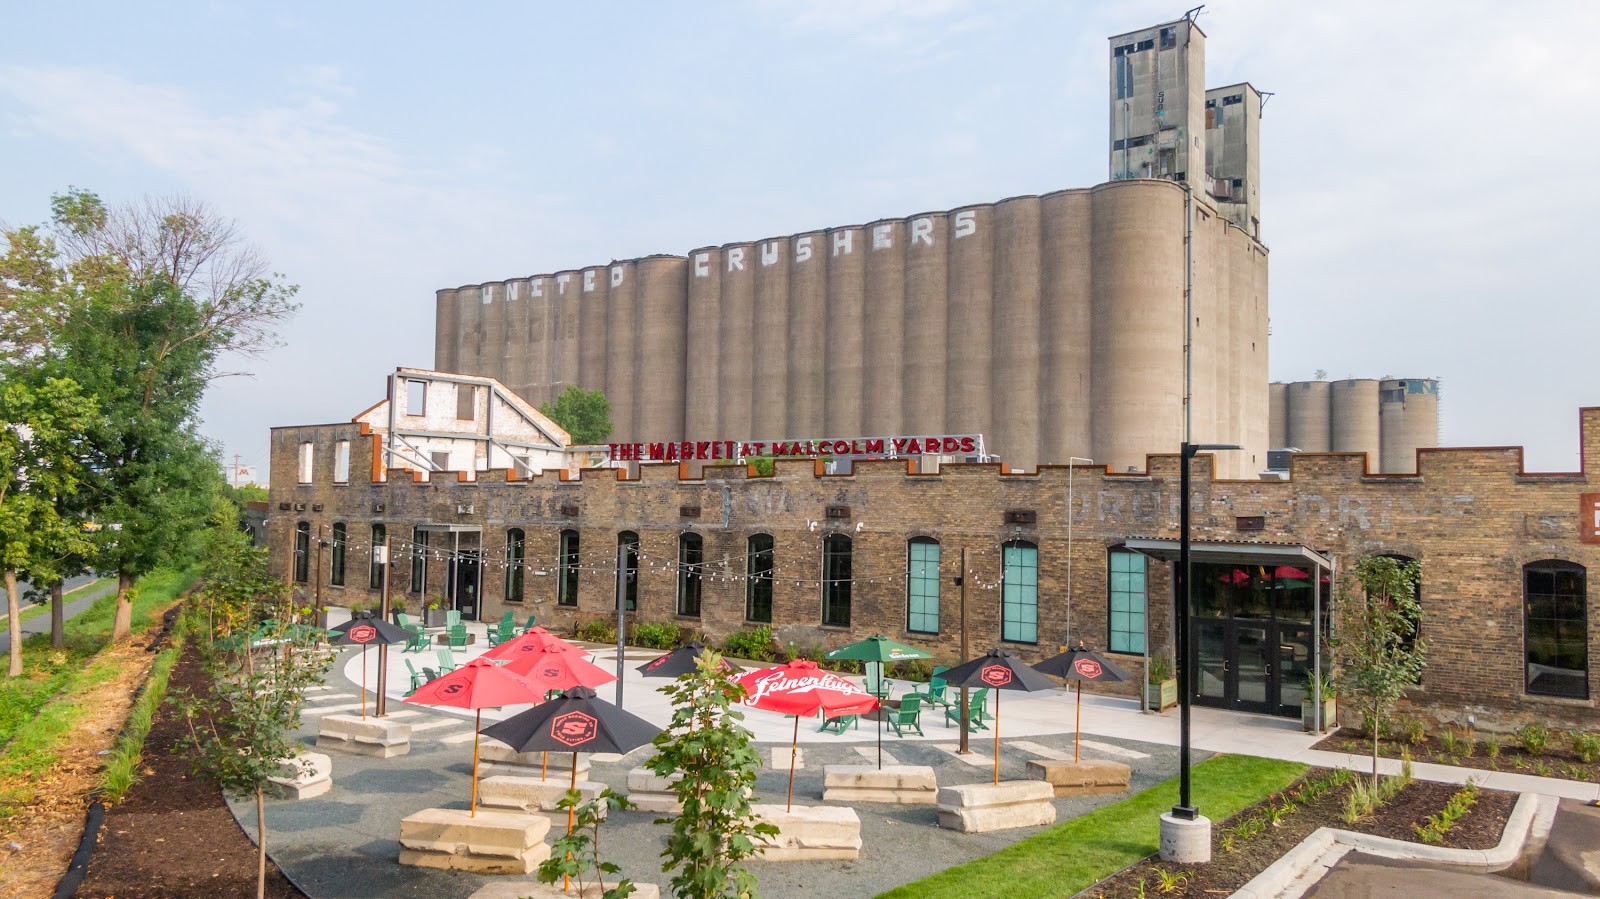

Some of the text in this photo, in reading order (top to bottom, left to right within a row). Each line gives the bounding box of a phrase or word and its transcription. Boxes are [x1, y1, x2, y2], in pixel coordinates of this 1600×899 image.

[482, 211, 976, 305] UNITED CRUSHERS
[609, 437, 977, 461] THE MARKET AT MALCOLM YARDS
[562, 721, 588, 735] S
